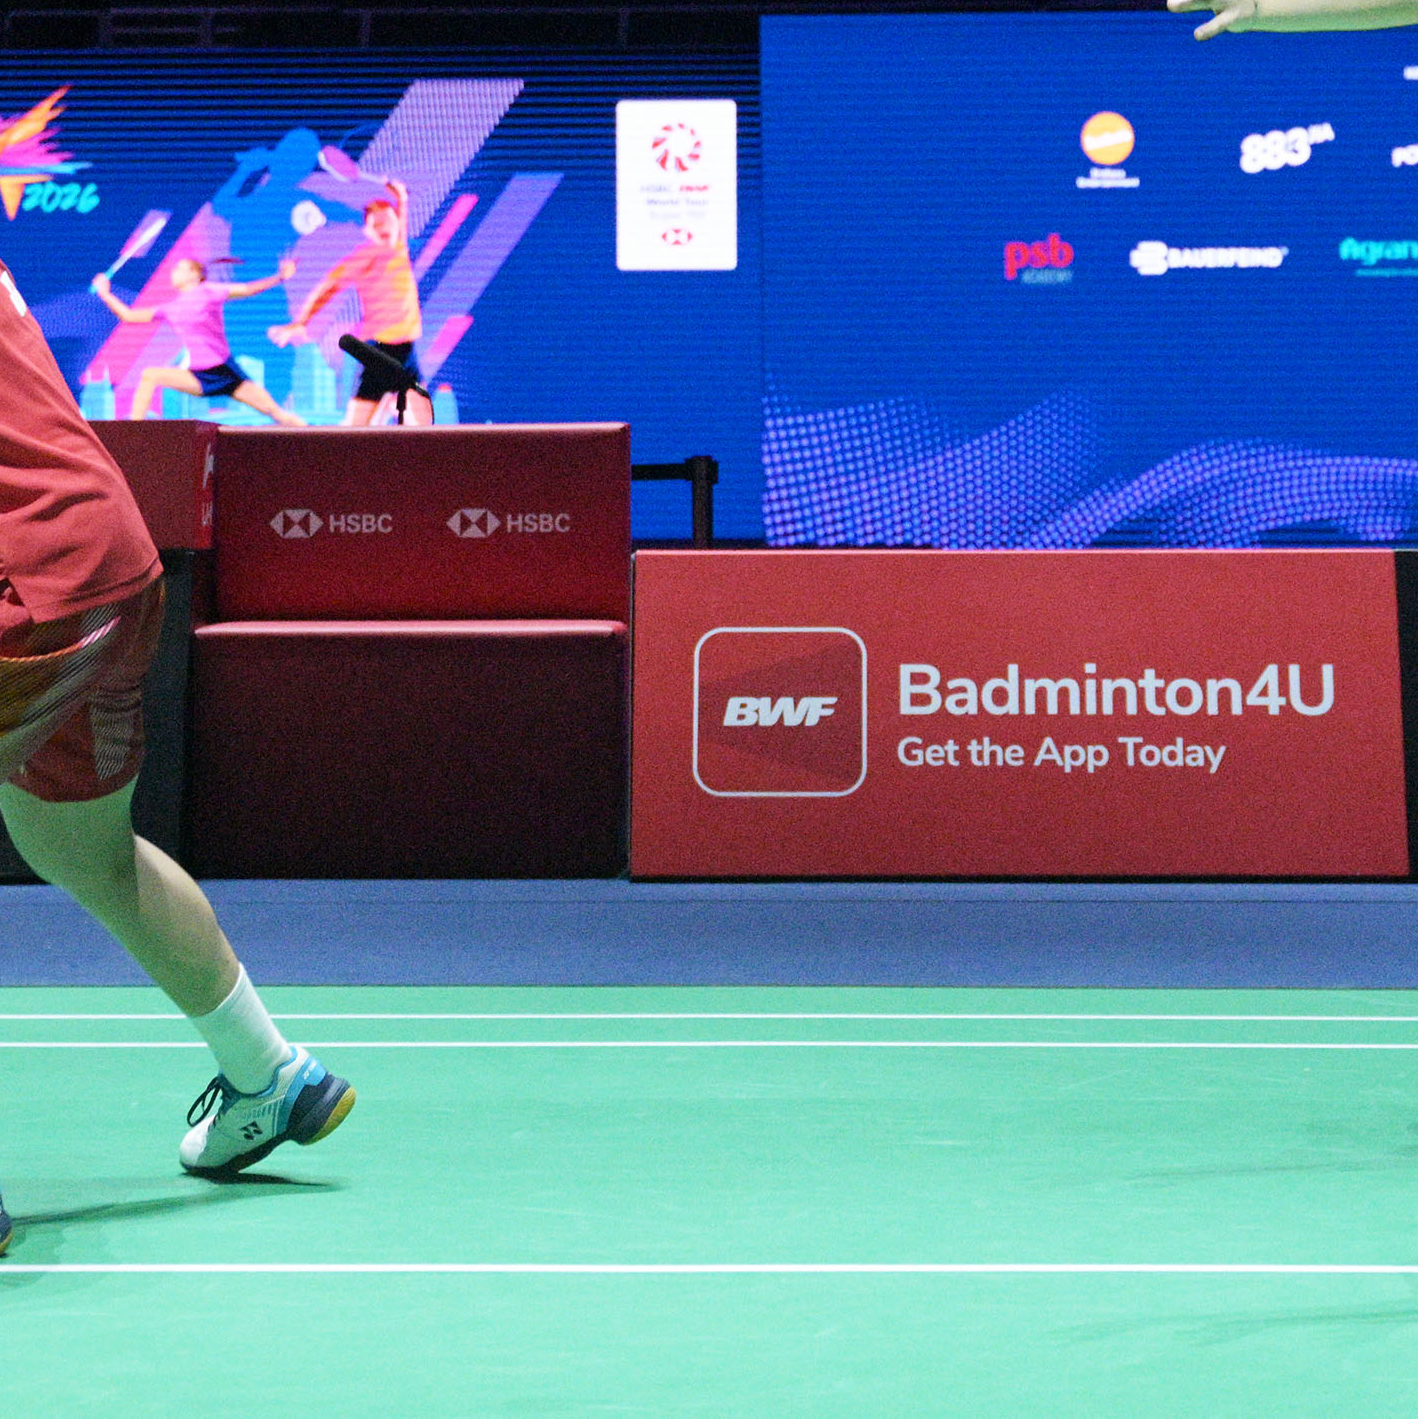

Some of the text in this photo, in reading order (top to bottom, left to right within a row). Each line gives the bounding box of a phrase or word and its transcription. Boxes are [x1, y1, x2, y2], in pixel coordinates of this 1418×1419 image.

[1240, 127, 1312, 173] 883
[21, 180, 100, 214] 2026
[1004, 233, 1074, 280] psb
[329, 514, 393, 533] HSBC
[506, 513, 571, 533] HSBC
[897, 662, 1337, 717] Badminton4U
[722, 696, 839, 728] BWF
[896, 736, 1227, 773] Get the App Today
